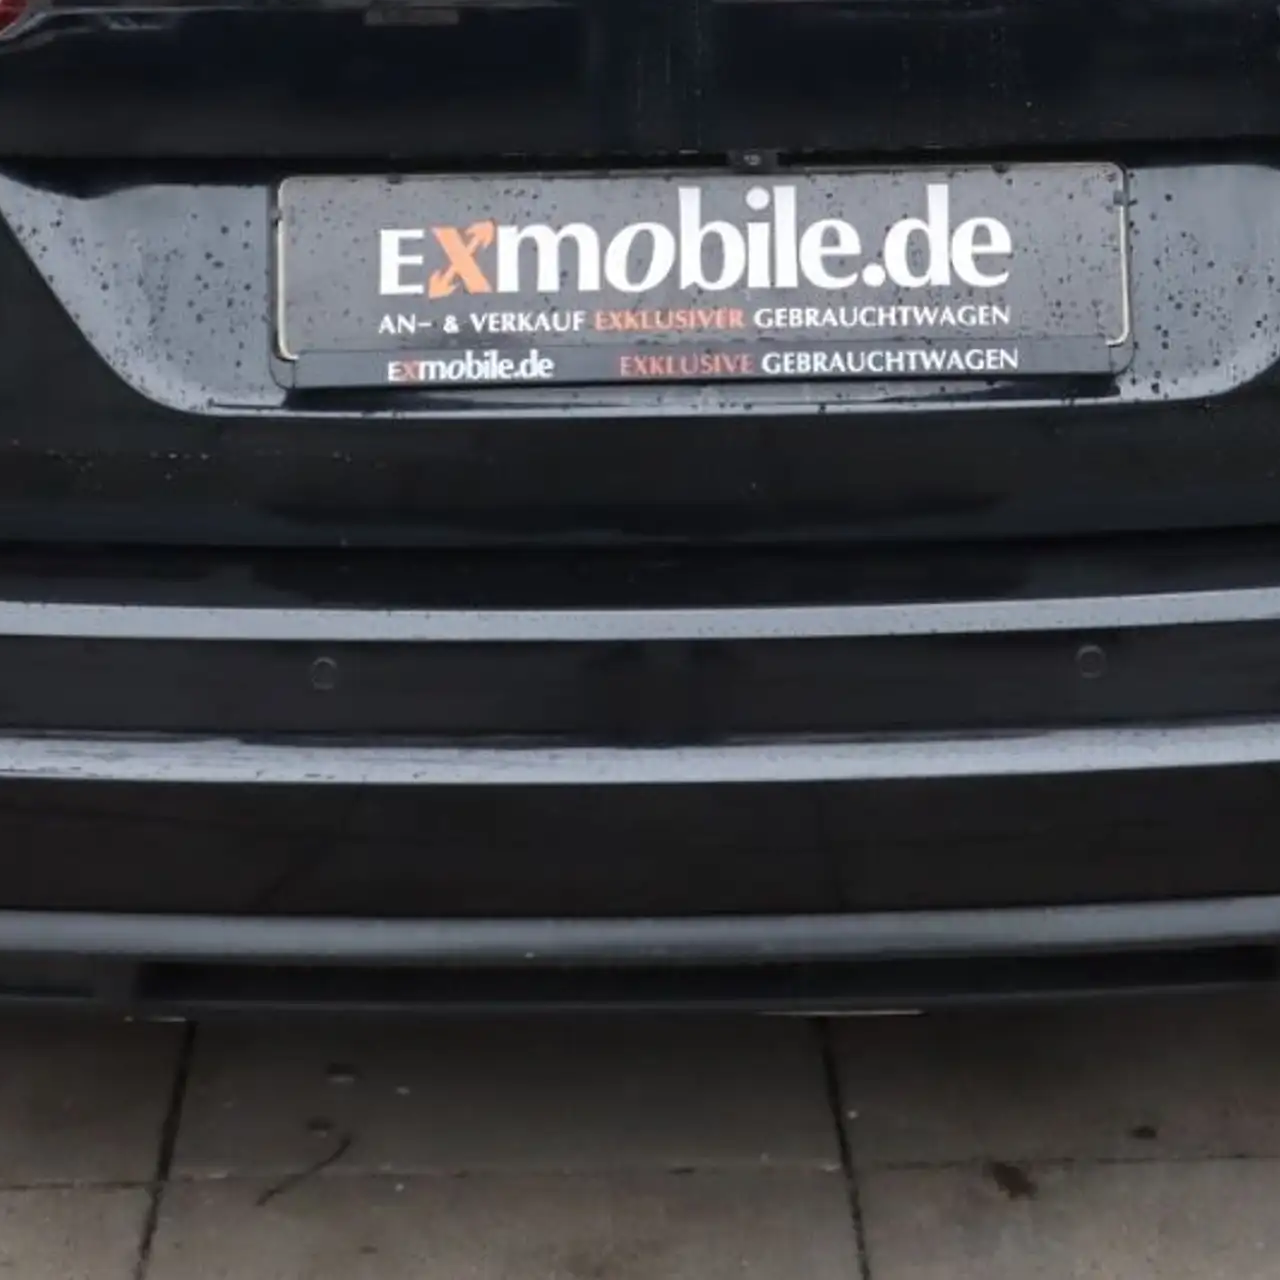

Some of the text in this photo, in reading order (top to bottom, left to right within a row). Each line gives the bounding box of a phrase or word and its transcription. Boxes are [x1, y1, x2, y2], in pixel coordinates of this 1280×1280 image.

[442, 315, 460, 334] &
[470, 310, 586, 332] VERKAUF
[595, 308, 745, 332] EXKLUSIVER
[753, 305, 1011, 329] GEBRAUCHTWAGEN
[619, 348, 1019, 376] EXKLUSIVE GEBRAUCHTWAGEN
